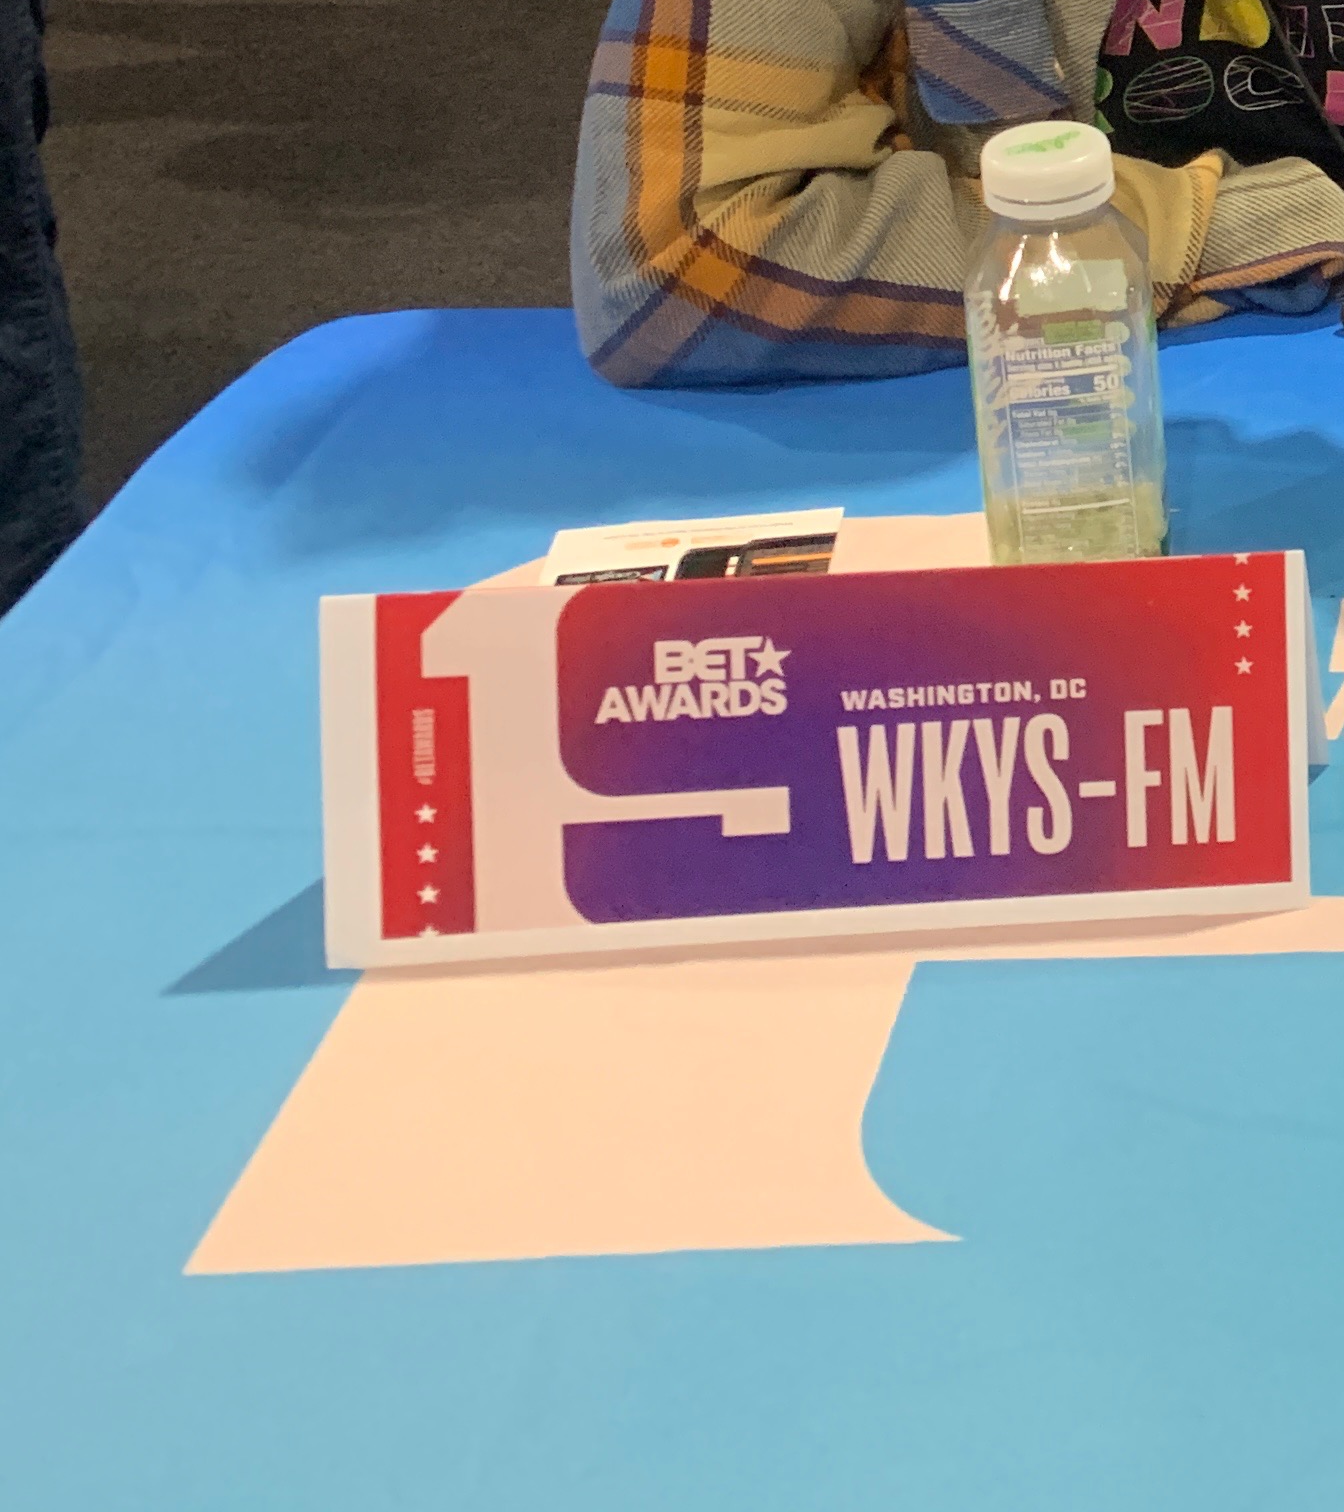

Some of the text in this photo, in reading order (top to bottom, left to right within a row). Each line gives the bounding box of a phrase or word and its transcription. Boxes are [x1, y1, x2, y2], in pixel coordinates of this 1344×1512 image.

[1004, 343, 1117, 362] Nutrition Facts
[1010, 373, 1120, 400] lories 50
[654, 636, 764, 685] BET
[594, 678, 788, 725] AWARDS
[841, 678, 1088, 712] WASHINGTON, DC
[837, 705, 1237, 865] WKYS-FM
